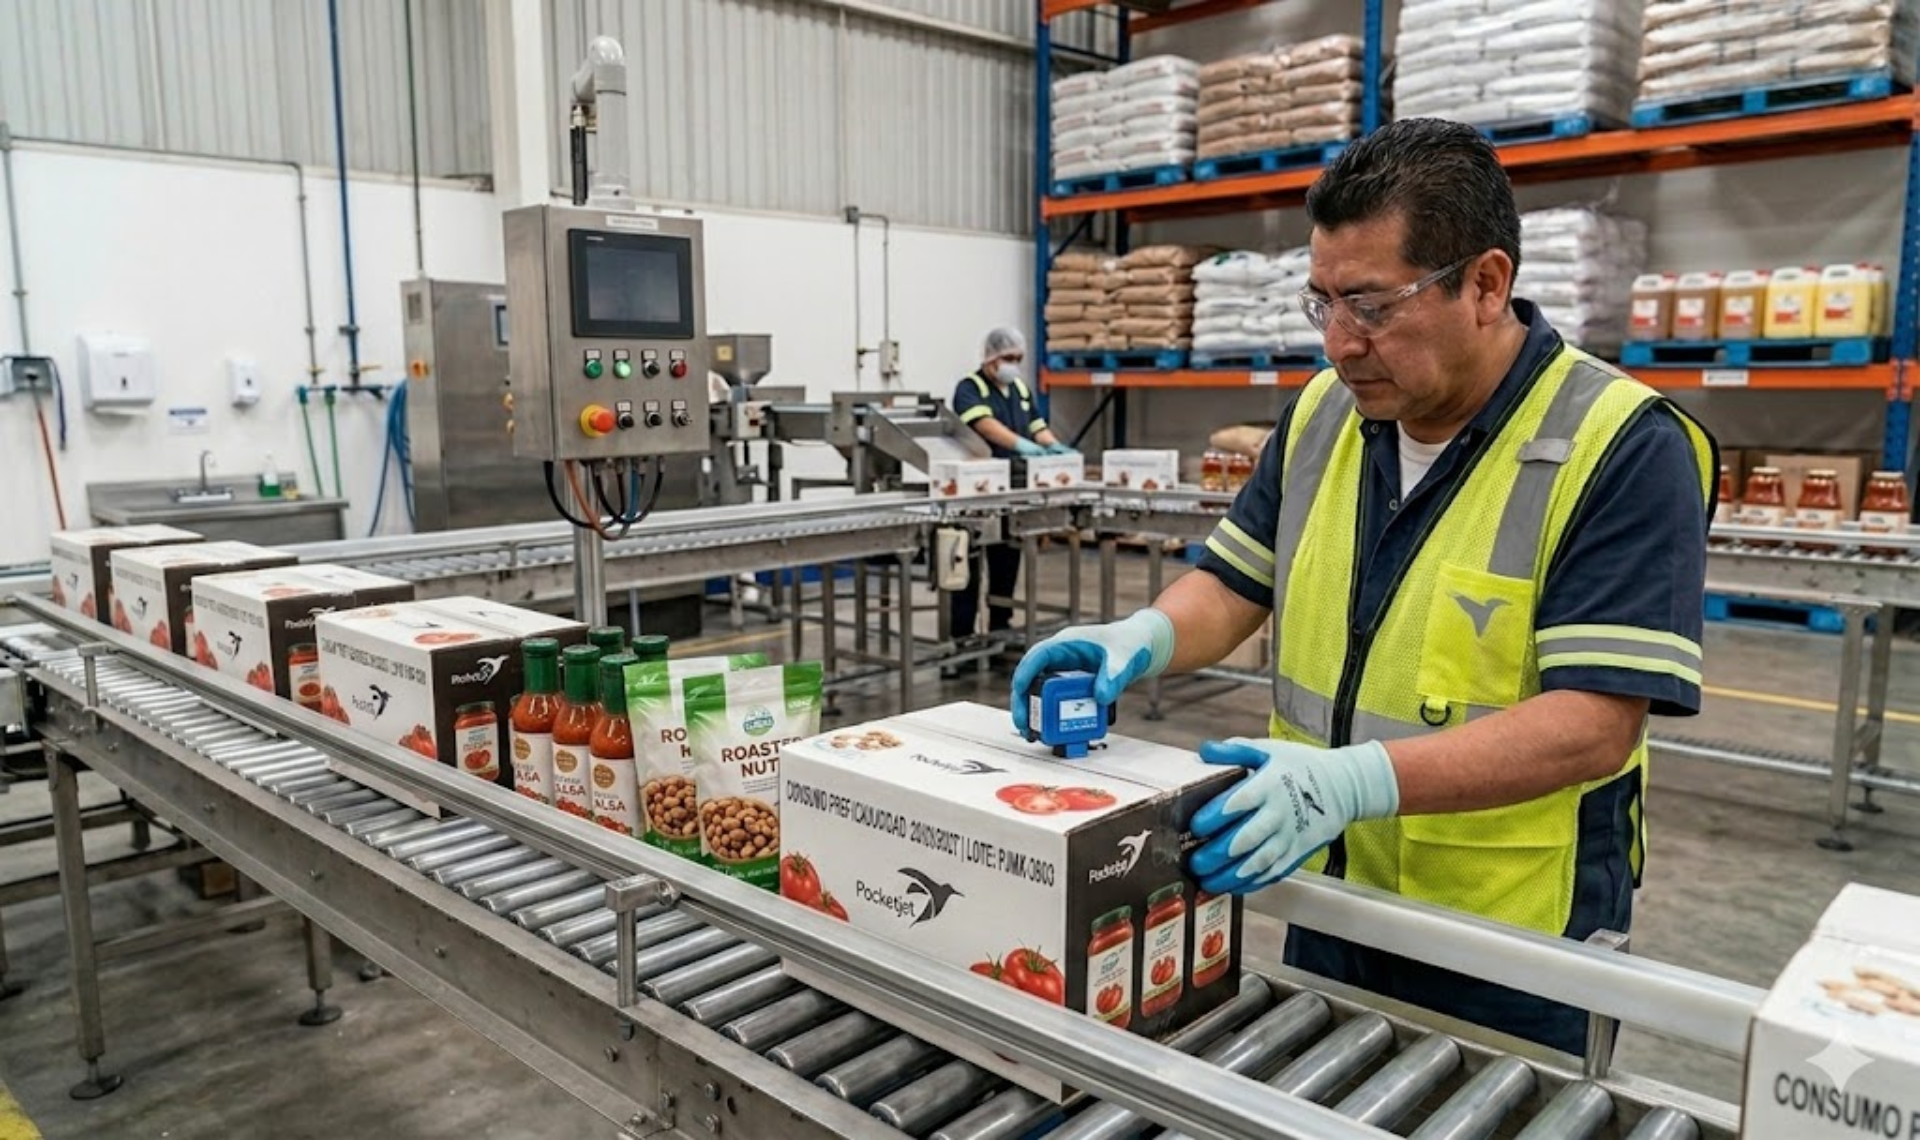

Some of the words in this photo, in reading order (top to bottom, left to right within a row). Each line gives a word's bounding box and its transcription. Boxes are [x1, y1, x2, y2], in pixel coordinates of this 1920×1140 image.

[721, 737, 802, 762] ROAST
[967, 838, 996, 868] LOTE:
[856, 879, 916, 918] Pocketjet
[1774, 1072, 1902, 1139] CONSUMO
